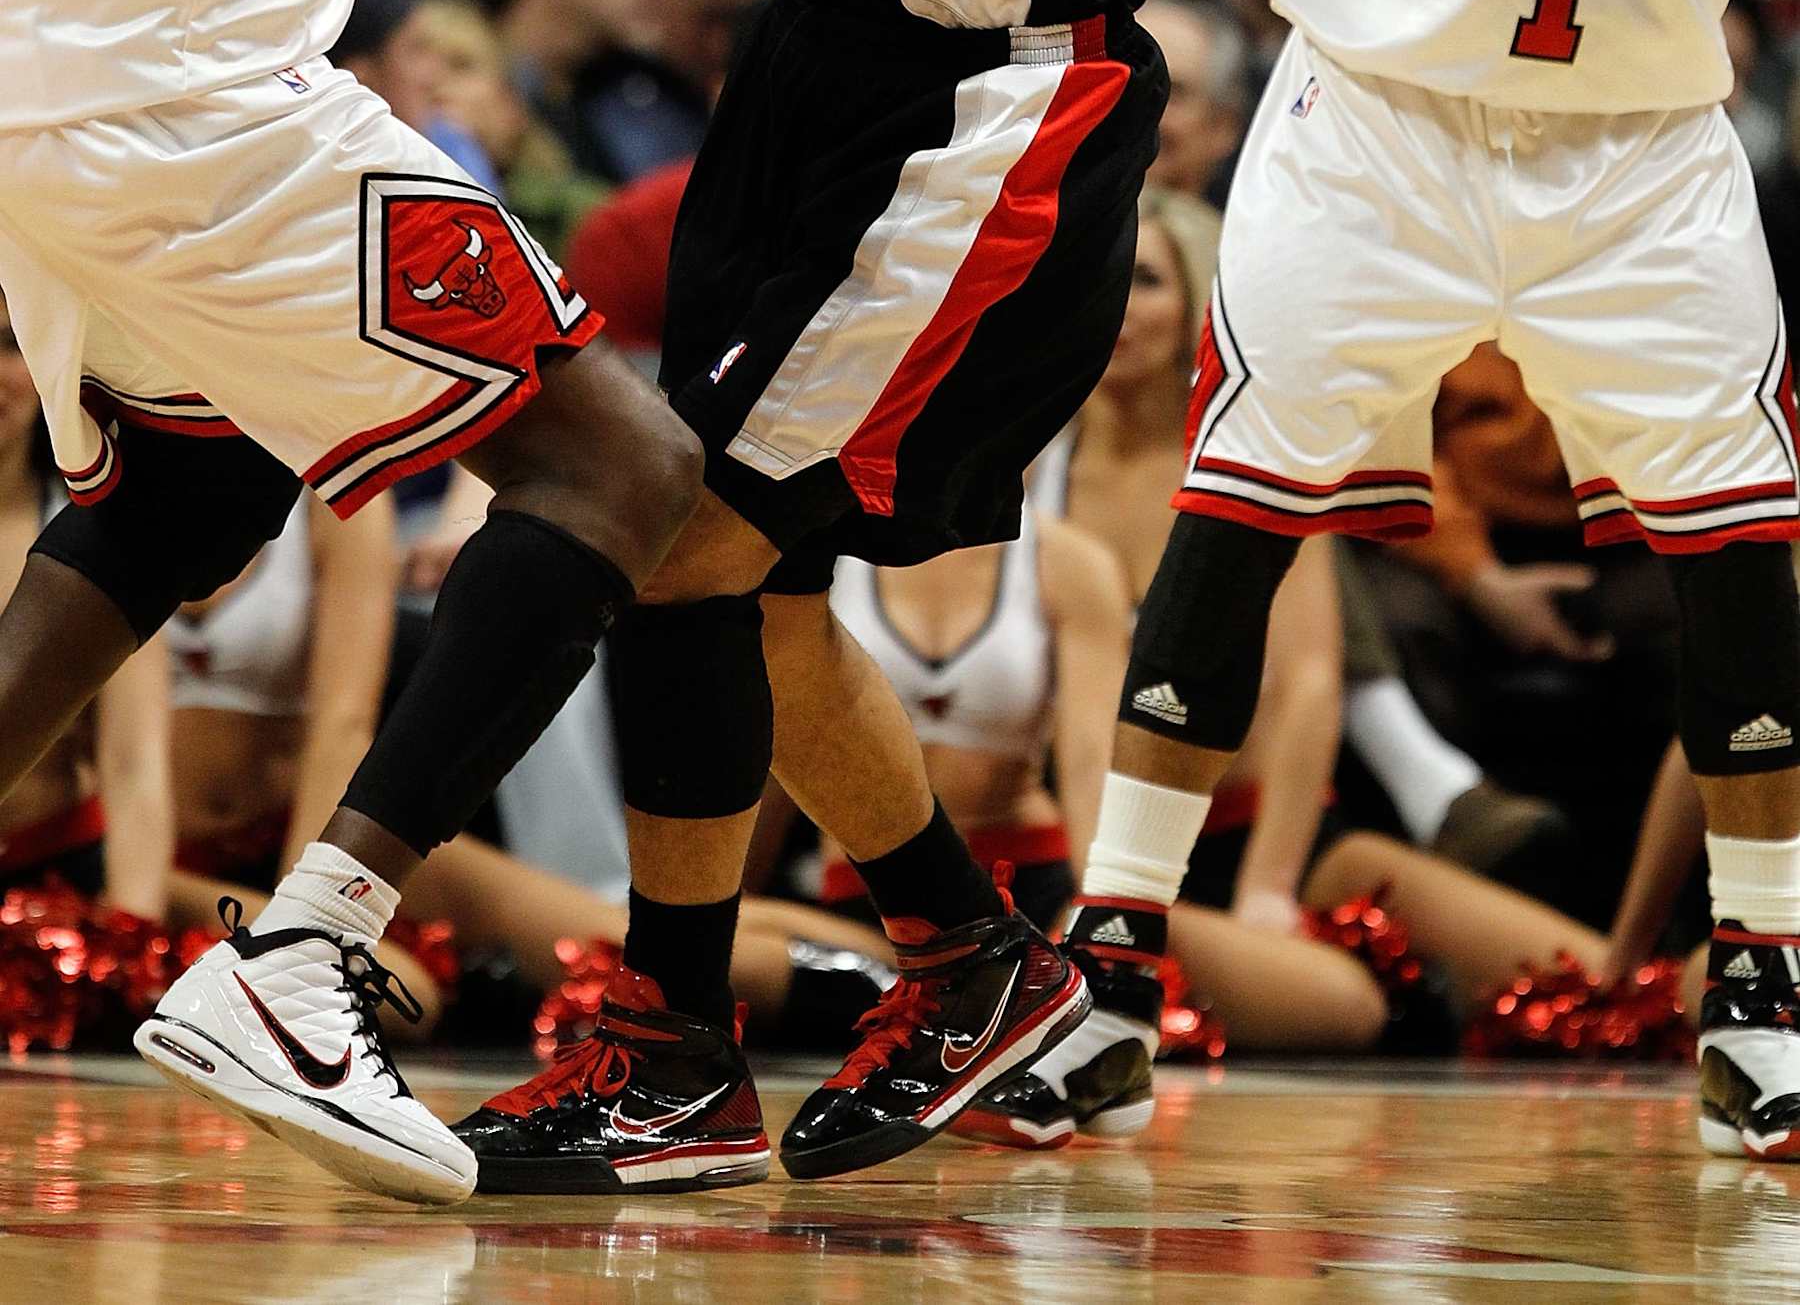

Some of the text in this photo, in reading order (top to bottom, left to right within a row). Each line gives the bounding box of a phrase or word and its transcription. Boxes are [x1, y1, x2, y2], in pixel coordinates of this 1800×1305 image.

[1133, 692, 1188, 716] adidas
[1730, 726, 1792, 742] adidas
[1090, 931, 1135, 946] adidas
